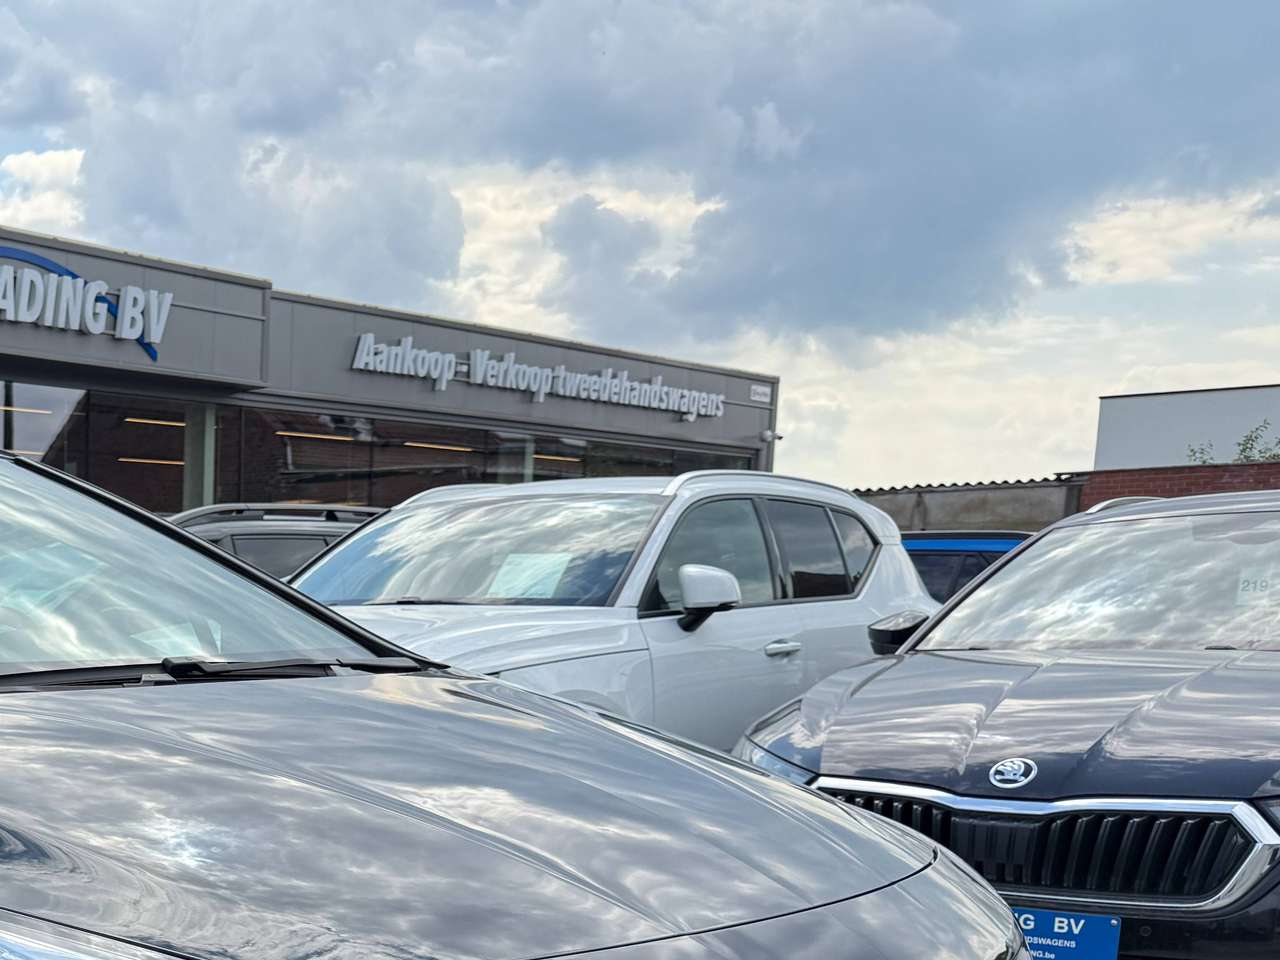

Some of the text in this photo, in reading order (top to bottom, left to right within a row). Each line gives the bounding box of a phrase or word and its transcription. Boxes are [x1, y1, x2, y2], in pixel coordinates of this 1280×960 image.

[115, 285, 174, 344] BV
[353, 332, 456, 391] Aankoop
[470, 349, 553, 403] Verkoop
[552, 365, 726, 422] tweedehandswagens
[1240, 579, 1269, 592] 219
[1053, 916, 1086, 935] BV
[1024, 936, 1076, 948] DSWAGENS
